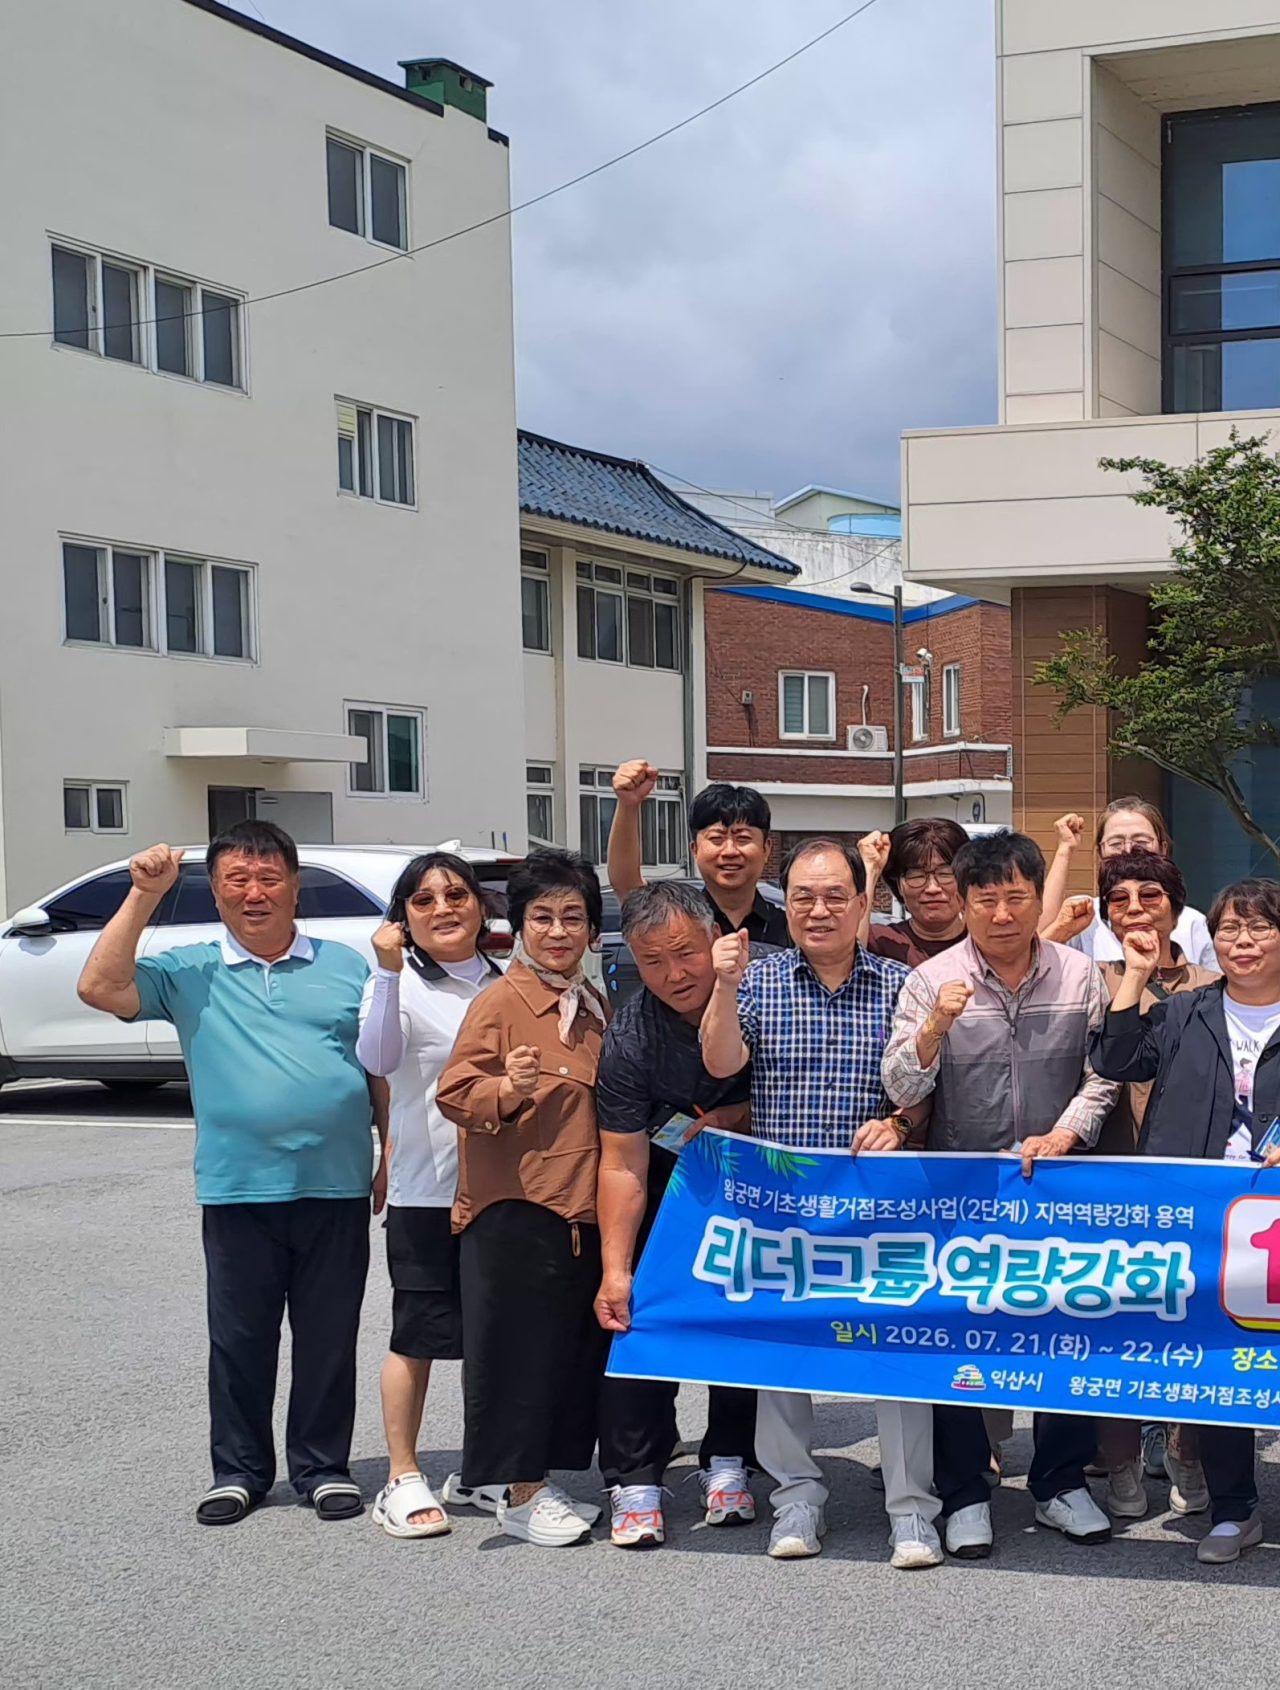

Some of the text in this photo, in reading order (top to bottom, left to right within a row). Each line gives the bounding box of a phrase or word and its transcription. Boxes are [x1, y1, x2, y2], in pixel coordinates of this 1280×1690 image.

[723, 1178, 1194, 1229] 왕궁면 기초생활거점조성사업(2단계) 지역역량강화 용역
[702, 1223, 1186, 1315] 리더그룹 역량강화
[829, 1320, 877, 1344] 일시
[884, 1325, 957, 1350] 2026.
[964, 1328, 1002, 1354] 07.
[1009, 1332, 1090, 1361] 21.(화)
[1119, 1339, 1204, 1368] 22.(수)
[1230, 1346, 1278, 1372] 장소
[989, 1369, 1043, 1392] 익산시
[1068, 1375, 1122, 1398] 왕궁면
